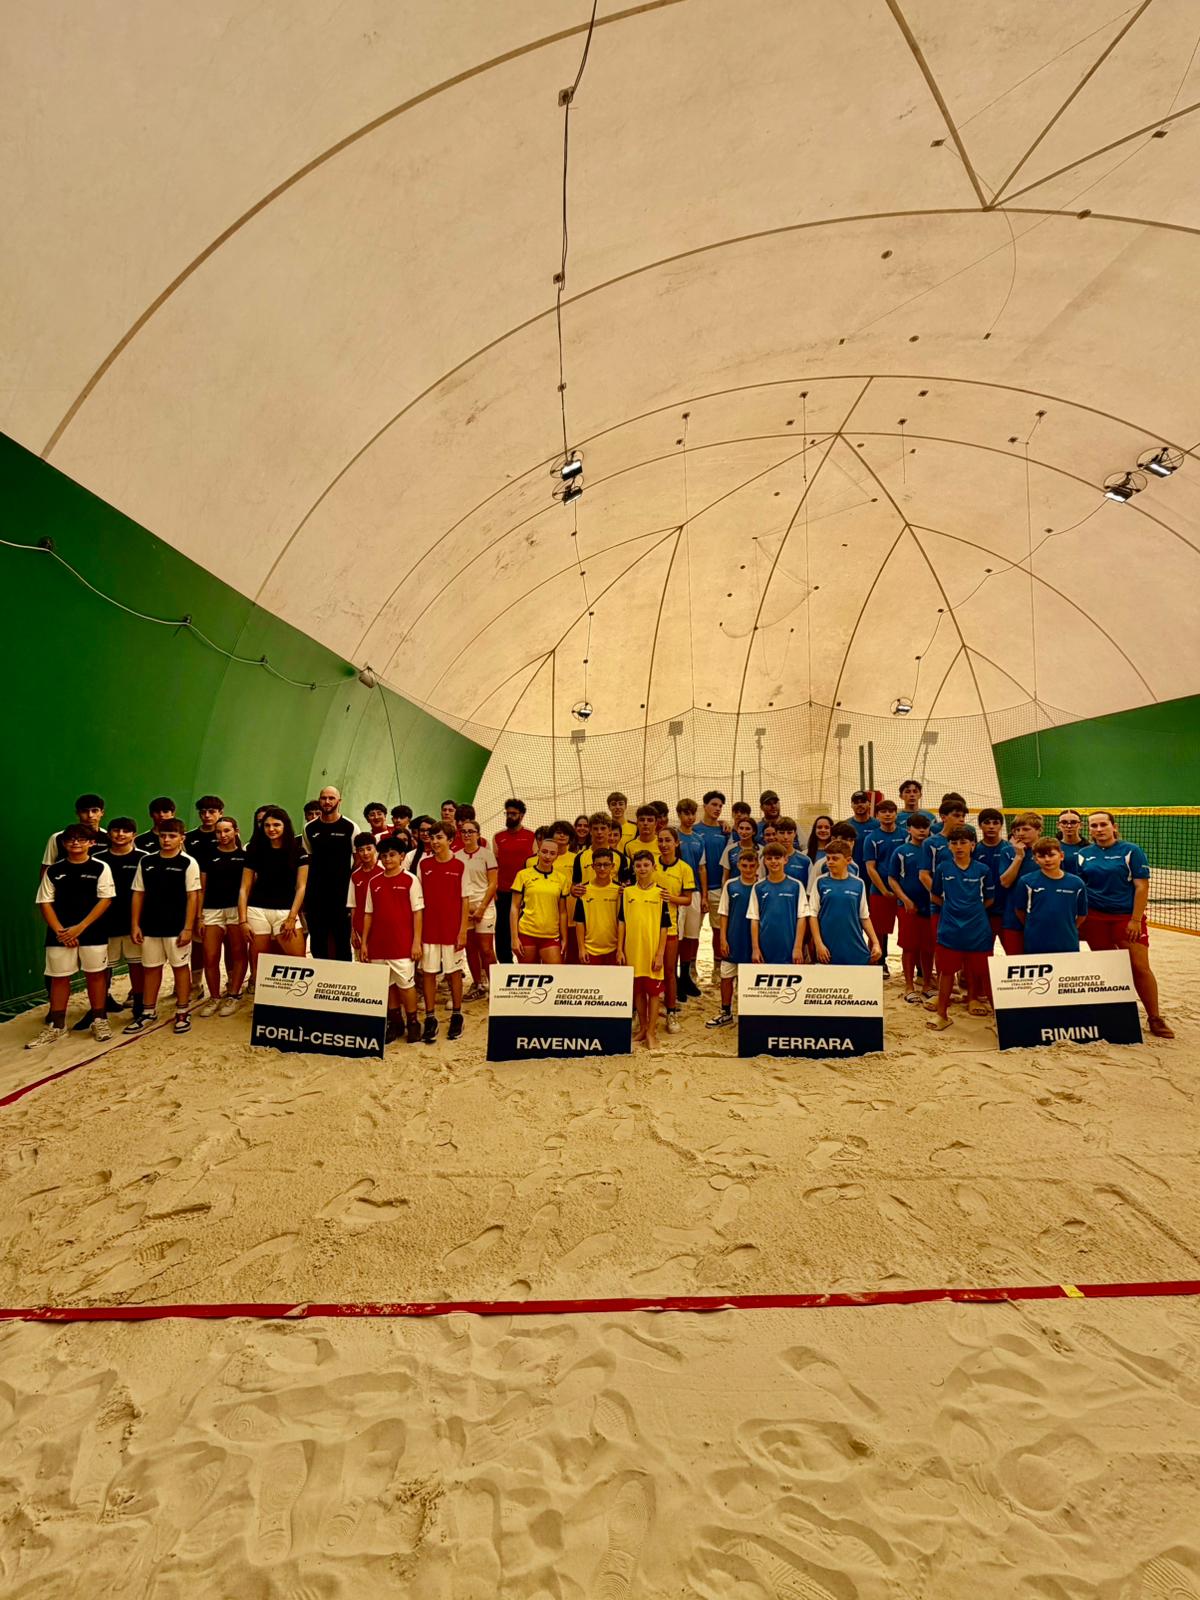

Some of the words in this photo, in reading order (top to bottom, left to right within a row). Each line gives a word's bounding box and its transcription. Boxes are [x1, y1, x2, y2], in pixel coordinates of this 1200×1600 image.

[271, 965, 315, 980] FITP
[1007, 964, 1053, 979] FITP
[1058, 974, 1101, 982] COMITATO
[316, 982, 357, 991] COMITATO
[505, 974, 554, 988] FITP
[754, 974, 803, 987] FITP
[315, 988, 360, 997] REGIONALE
[1057, 987, 1086, 995] EMILIA
[1087, 985, 1131, 993] ROMAGNA
[313, 994, 341, 1002] EMILIA
[341, 996, 383, 1005] ROMAGNA
[256, 1025, 380, 1050] FORLÌ-CESENA
[1041, 1025, 1099, 1041] RIMINI
[516, 1037, 602, 1051] RAVENNA
[768, 1037, 854, 1051] FERRARA
